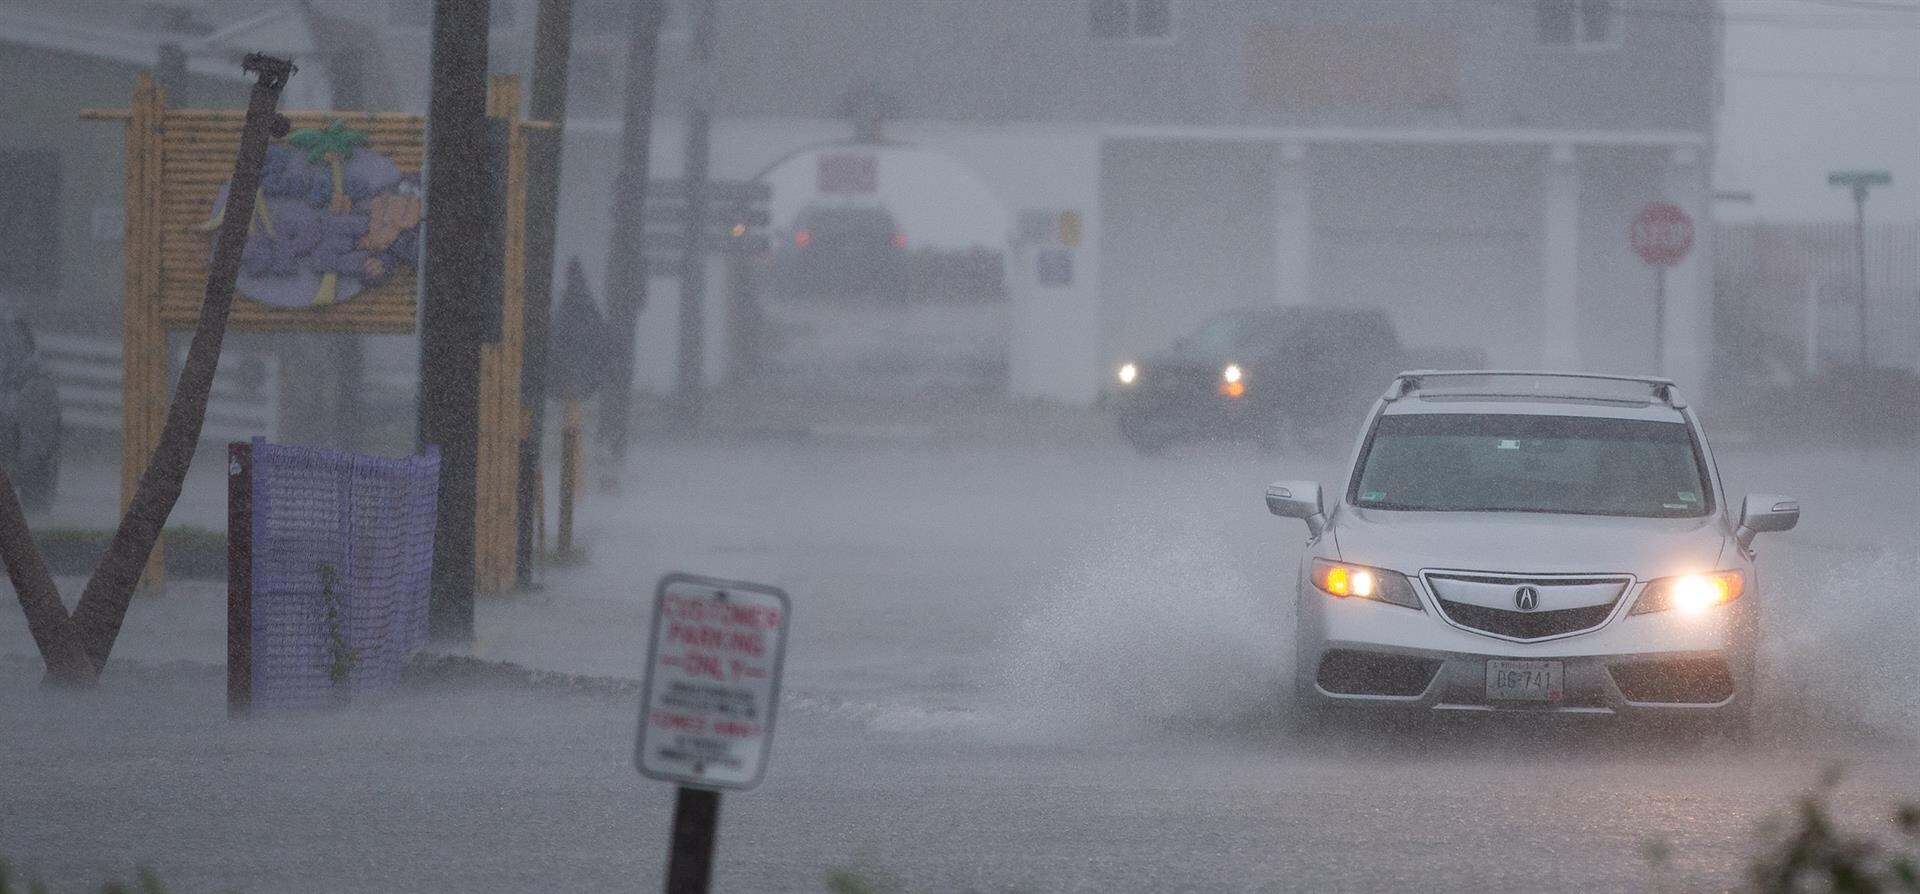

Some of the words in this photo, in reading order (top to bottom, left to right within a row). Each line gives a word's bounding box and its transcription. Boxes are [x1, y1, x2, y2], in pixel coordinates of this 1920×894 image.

[662, 592, 781, 628] CUSTOMER
[669, 623, 765, 657] PARKING
[683, 651, 744, 680] ONLY
